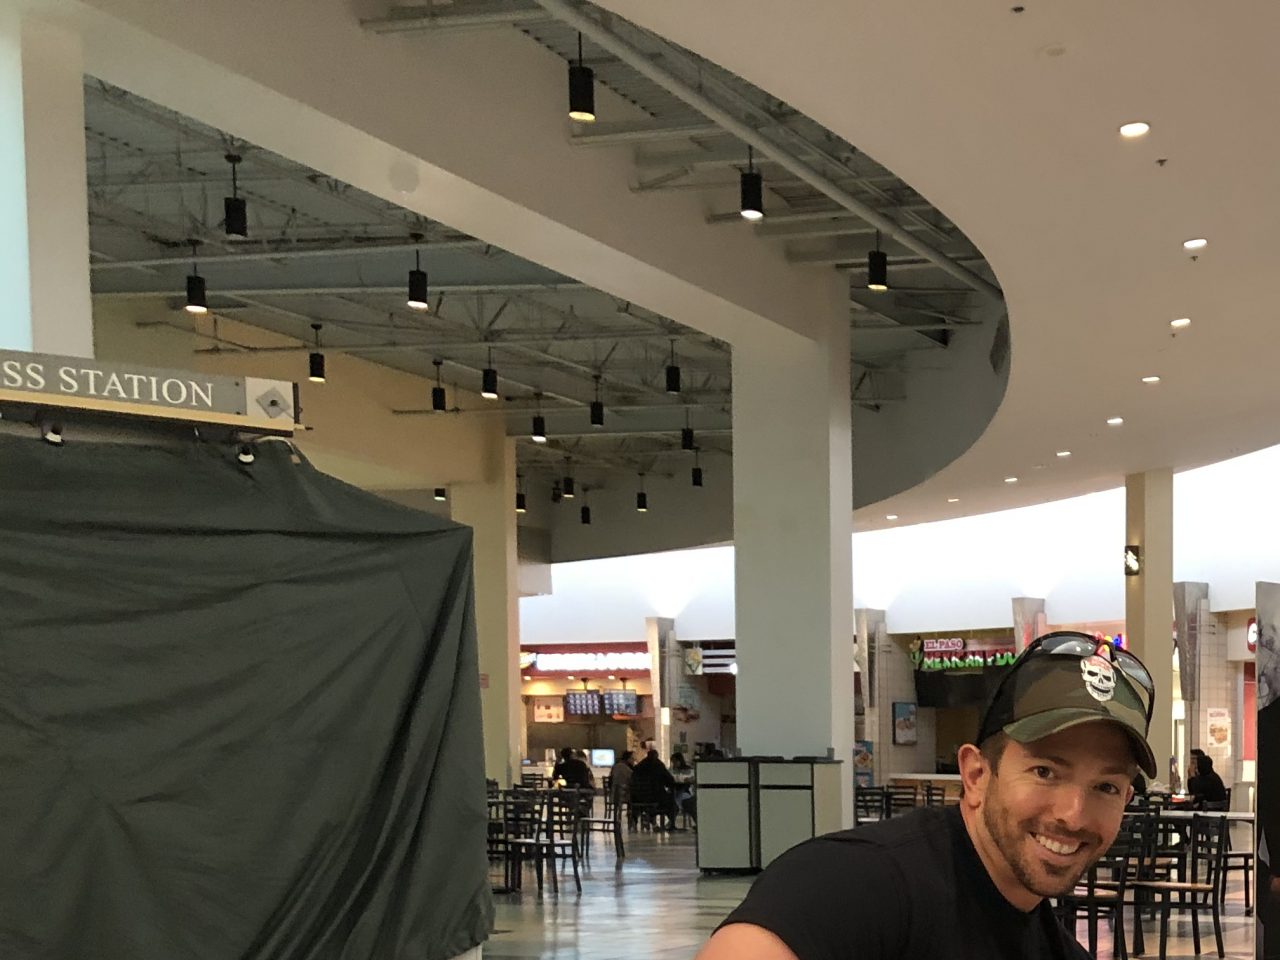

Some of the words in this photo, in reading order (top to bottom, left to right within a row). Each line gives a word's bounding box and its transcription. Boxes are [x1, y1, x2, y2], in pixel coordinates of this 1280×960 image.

[2, 360, 46, 389] SS
[58, 366, 214, 407] STATION
[924, 640, 937, 651] EL
[938, 638, 963, 650] PASO
[923, 651, 984, 668] MEXICAN
